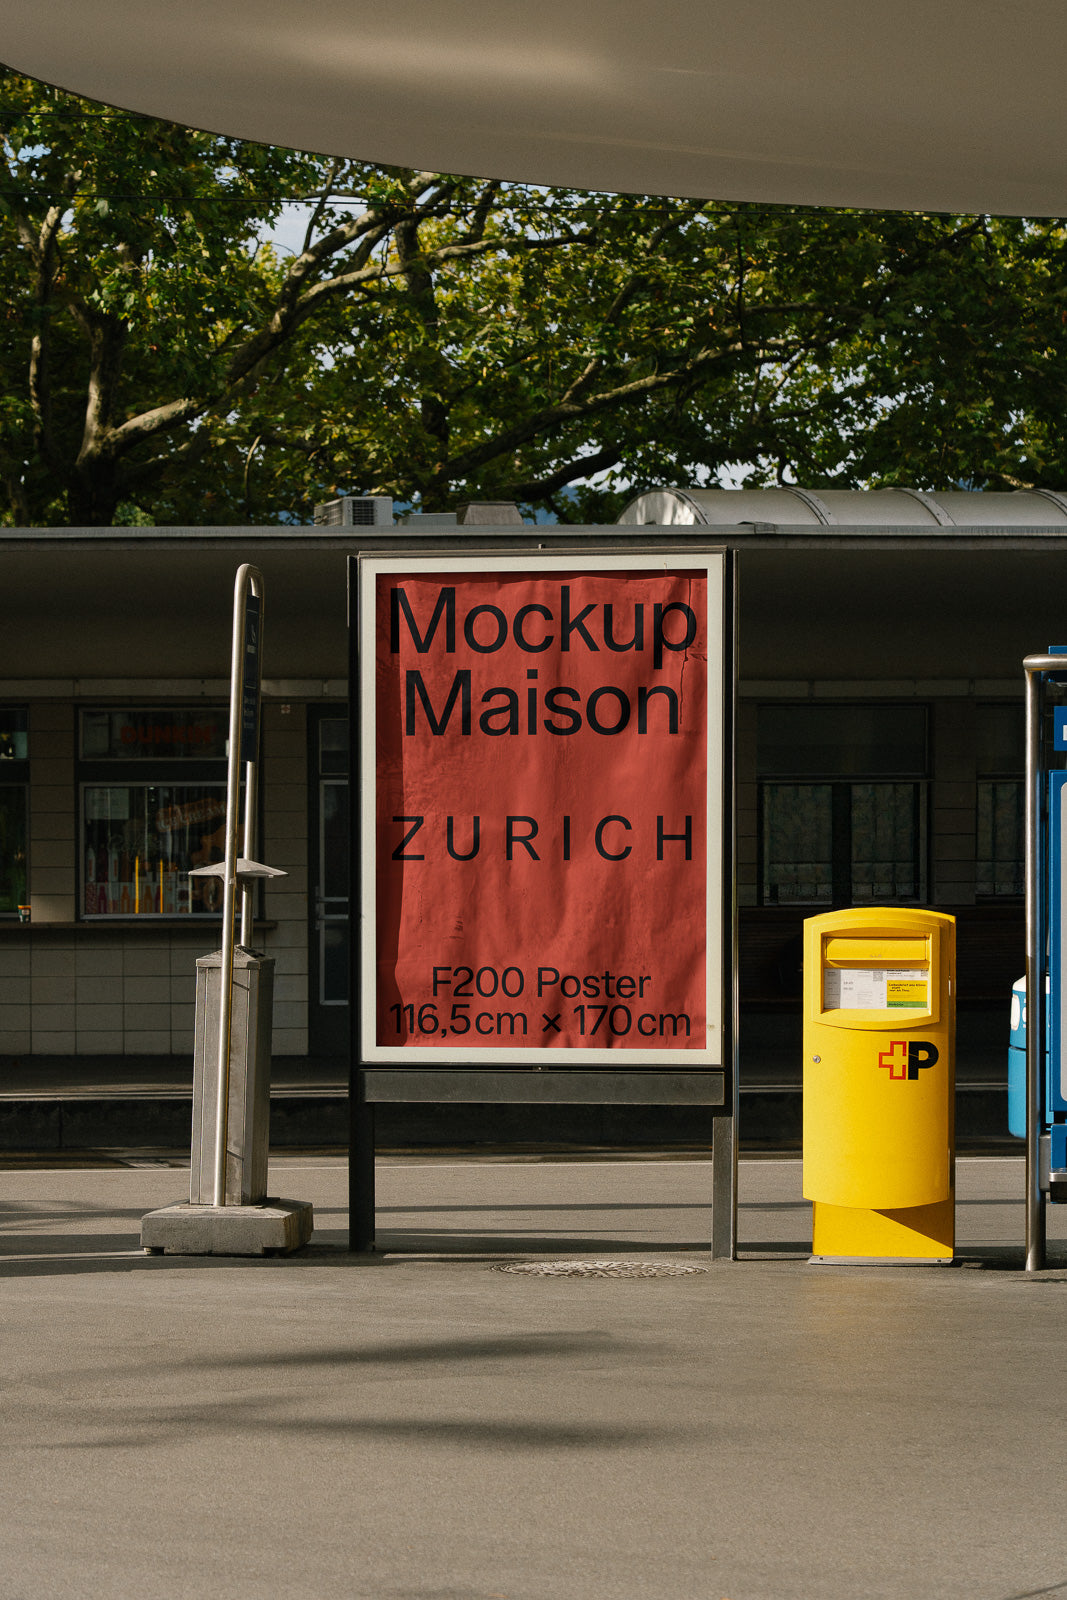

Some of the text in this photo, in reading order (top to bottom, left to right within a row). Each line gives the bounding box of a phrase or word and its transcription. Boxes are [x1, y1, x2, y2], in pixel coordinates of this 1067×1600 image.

[390, 585, 697, 669] Mockup
[405, 668, 679, 737] Maison
[391, 815, 693, 861] ZURICH
[432, 966, 652, 998] F200 Poster
[389, 1003, 528, 1039] 116,5cm
[573, 1004, 691, 1036] 170cm
[907, 1041, 940, 1080] P
